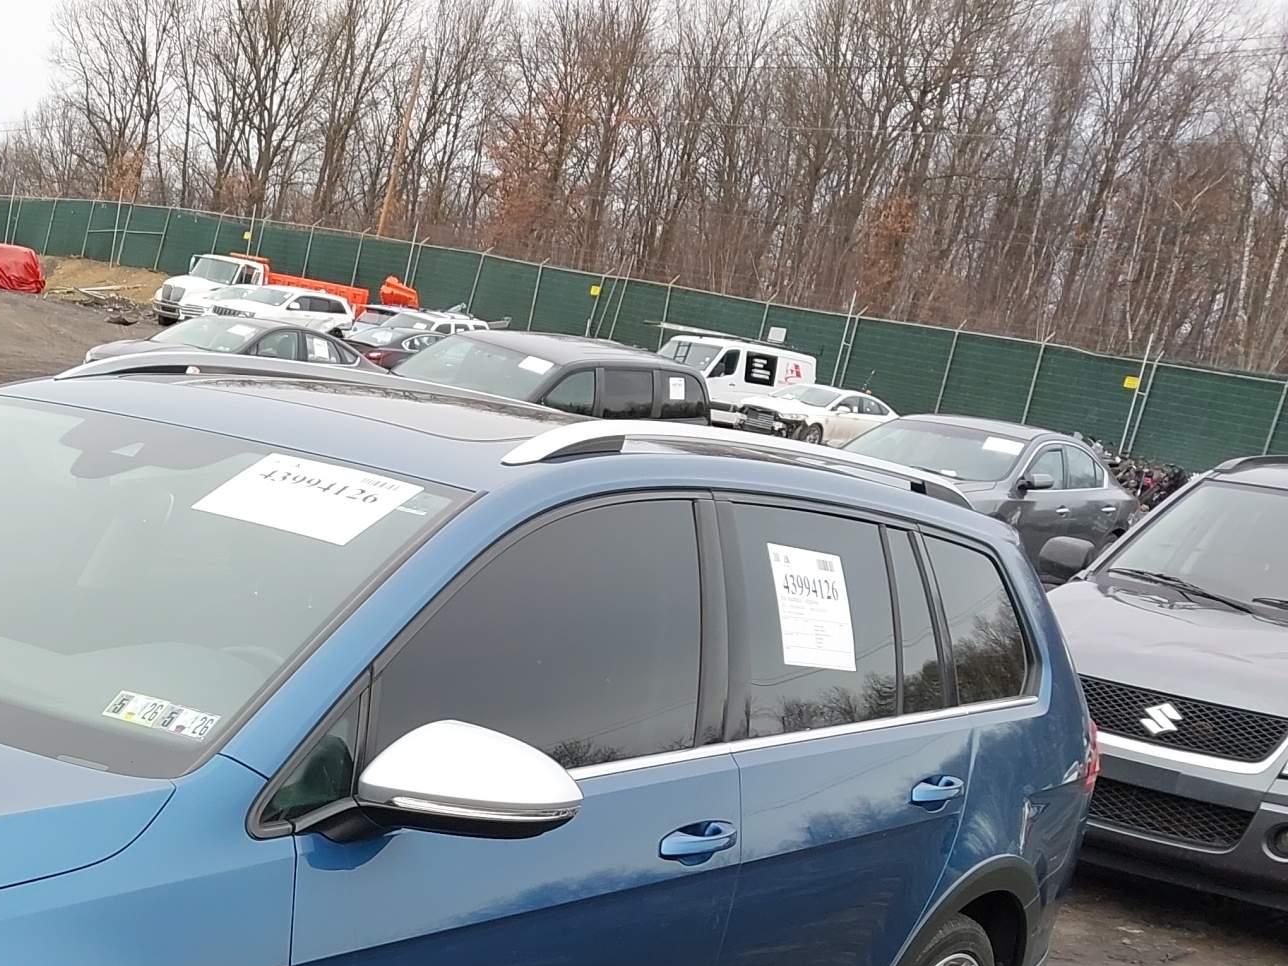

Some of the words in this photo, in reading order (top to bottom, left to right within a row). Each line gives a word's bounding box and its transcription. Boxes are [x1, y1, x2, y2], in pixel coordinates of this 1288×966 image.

[260, 470, 378, 504] 43994126
[783, 573, 839, 600] 43994126
[141, 702, 164, 721] 26
[192, 716, 214, 735] 26
